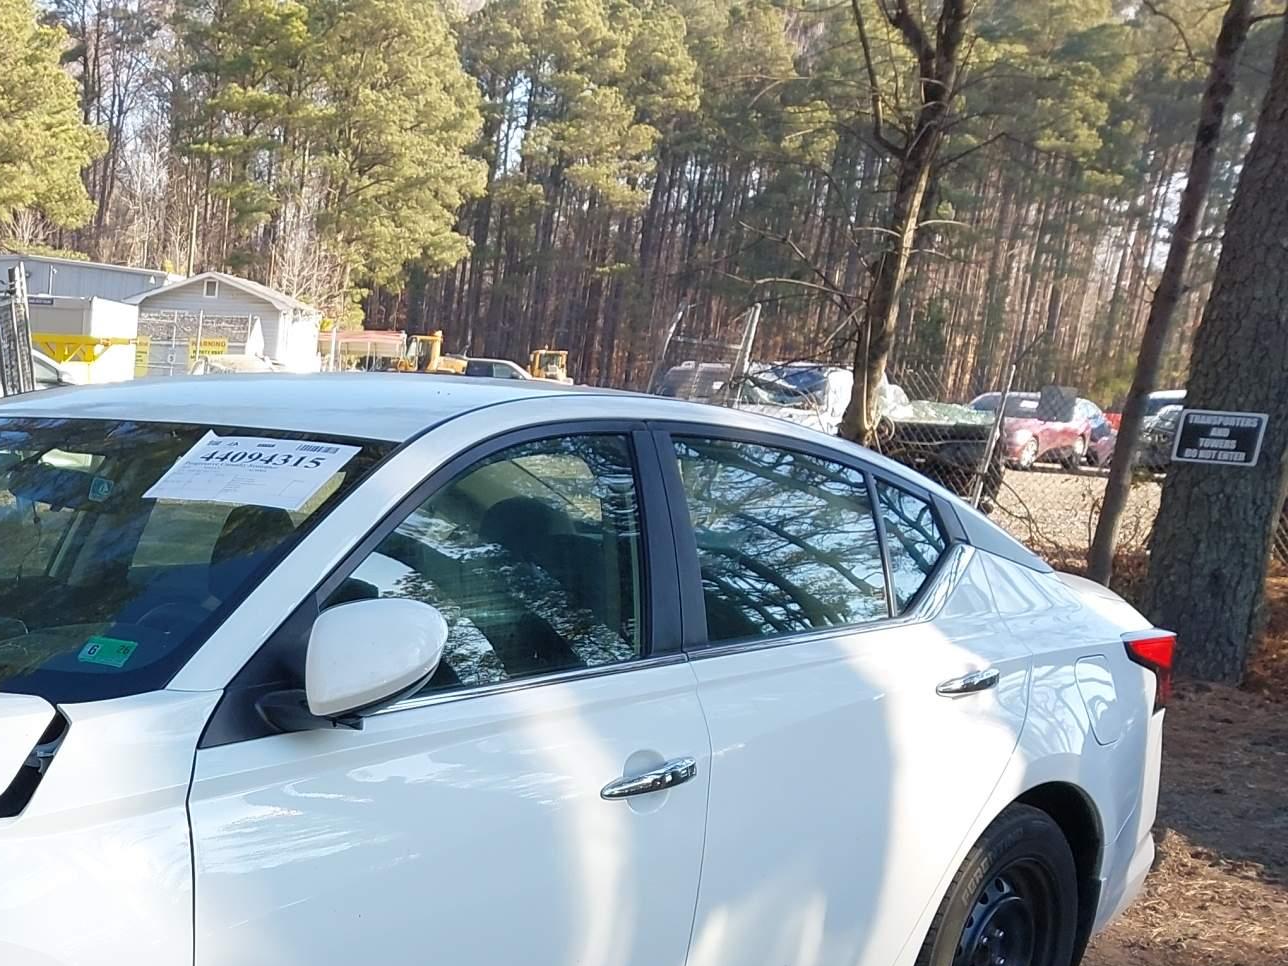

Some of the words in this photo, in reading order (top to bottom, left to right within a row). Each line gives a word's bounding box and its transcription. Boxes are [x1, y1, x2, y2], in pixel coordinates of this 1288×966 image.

[1188, 414, 1259, 428] TRANSPORTERS
[1210, 427, 1230, 437] AND
[1199, 437, 1237, 450] TOWERS
[200, 449, 326, 469] 44094315
[1184, 448, 1198, 458] DO
[1198, 450, 1218, 459] NOT
[1217, 451, 1246, 461] ENTER
[88, 645, 99, 655] 6
